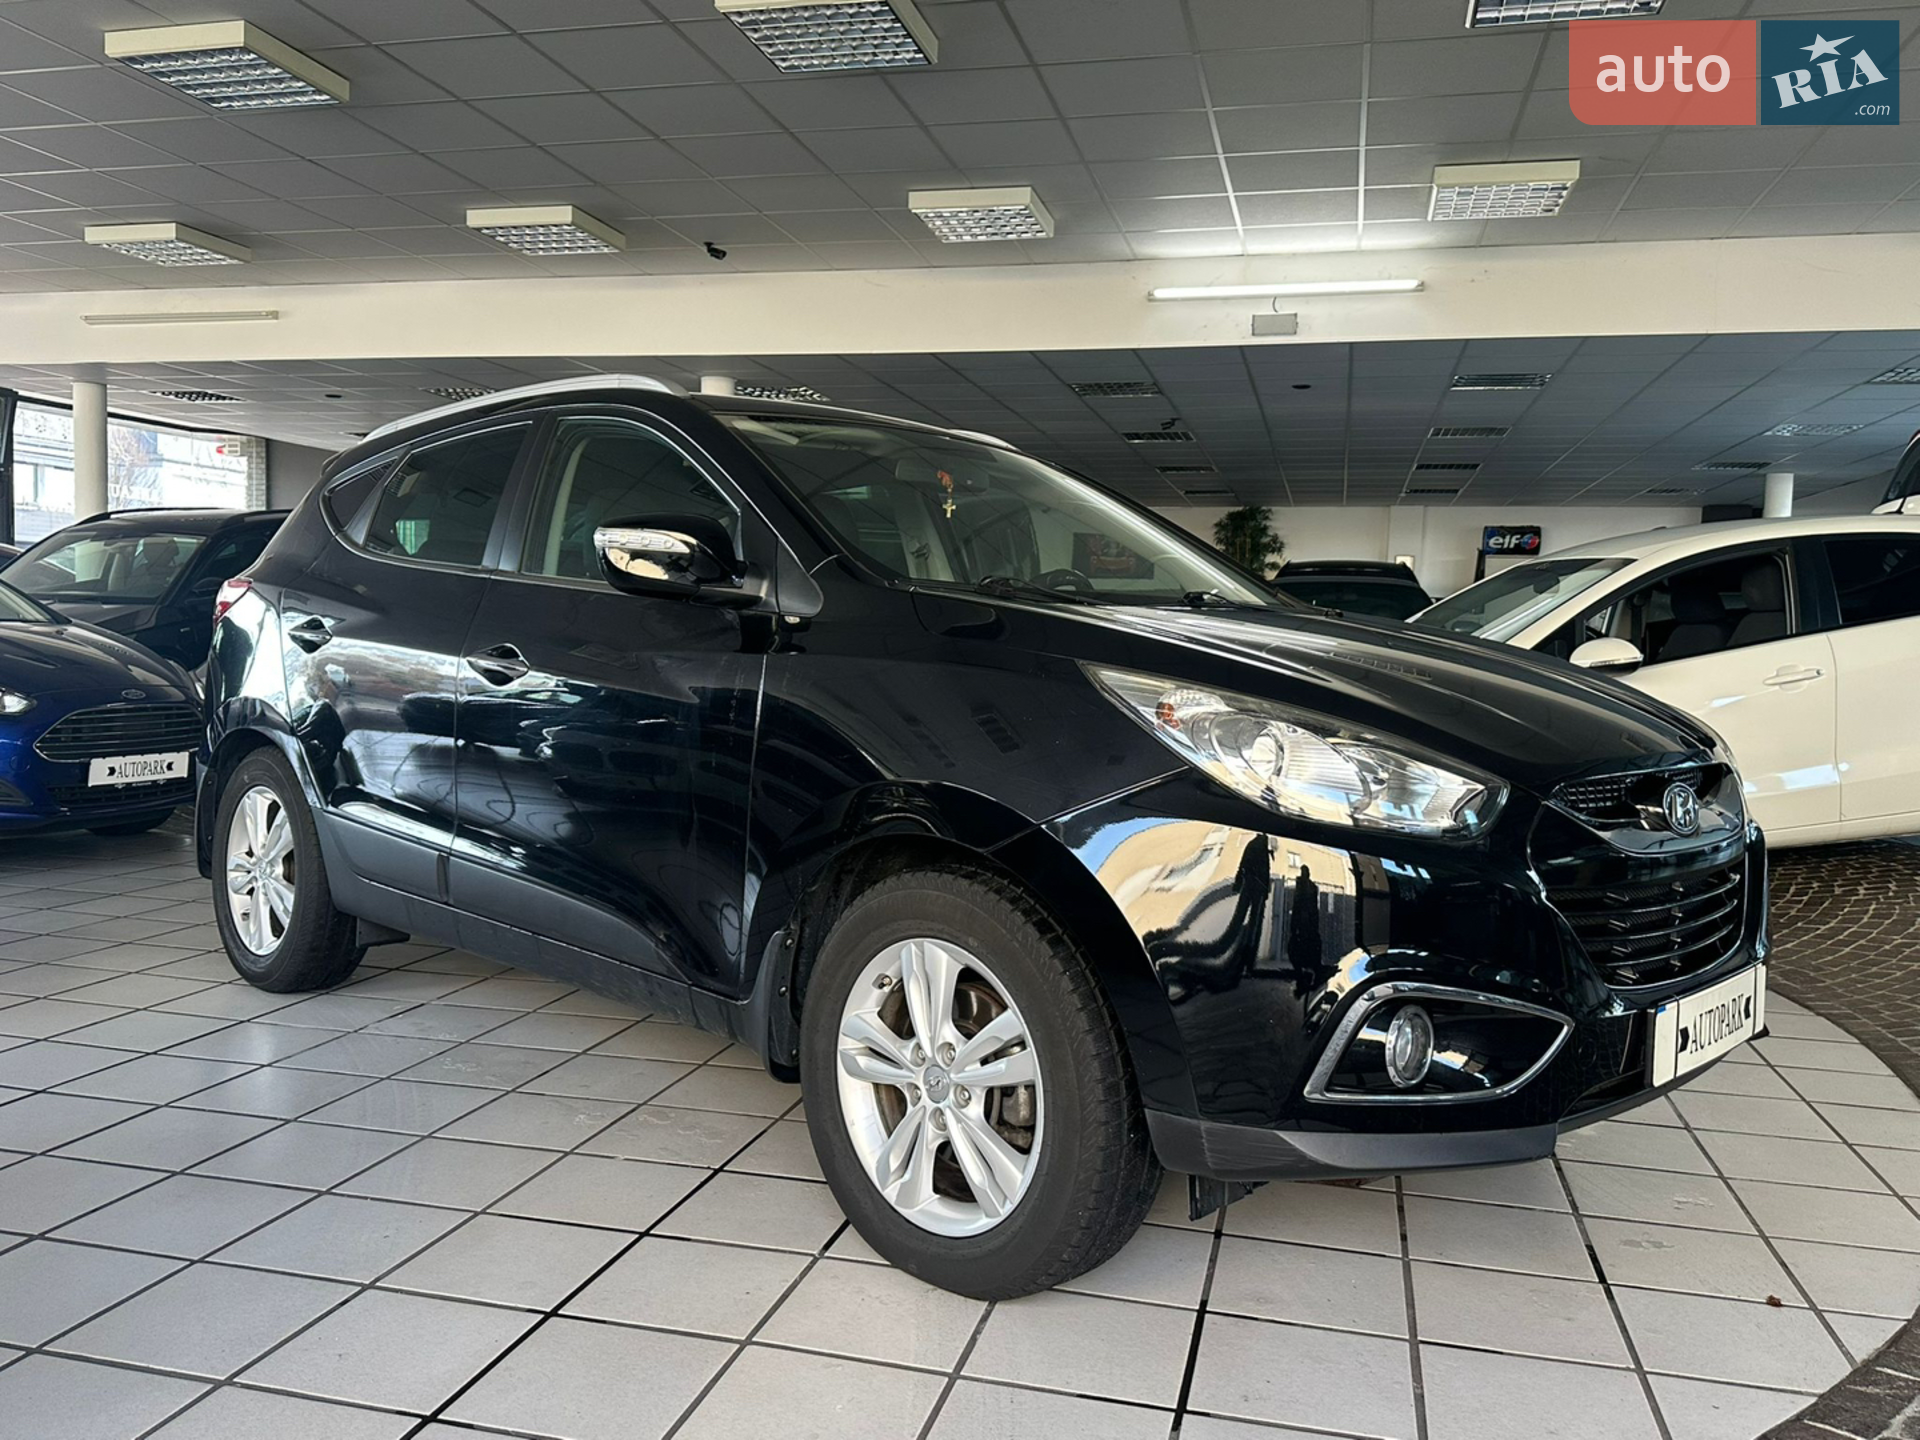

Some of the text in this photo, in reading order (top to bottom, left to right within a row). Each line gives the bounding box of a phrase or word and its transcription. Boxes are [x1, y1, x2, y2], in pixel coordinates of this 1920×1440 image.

[1488, 534, 1522, 549] elf
[116, 760, 166, 779] AUTOPARK
[1689, 993, 1744, 1054] AUTOPARK
